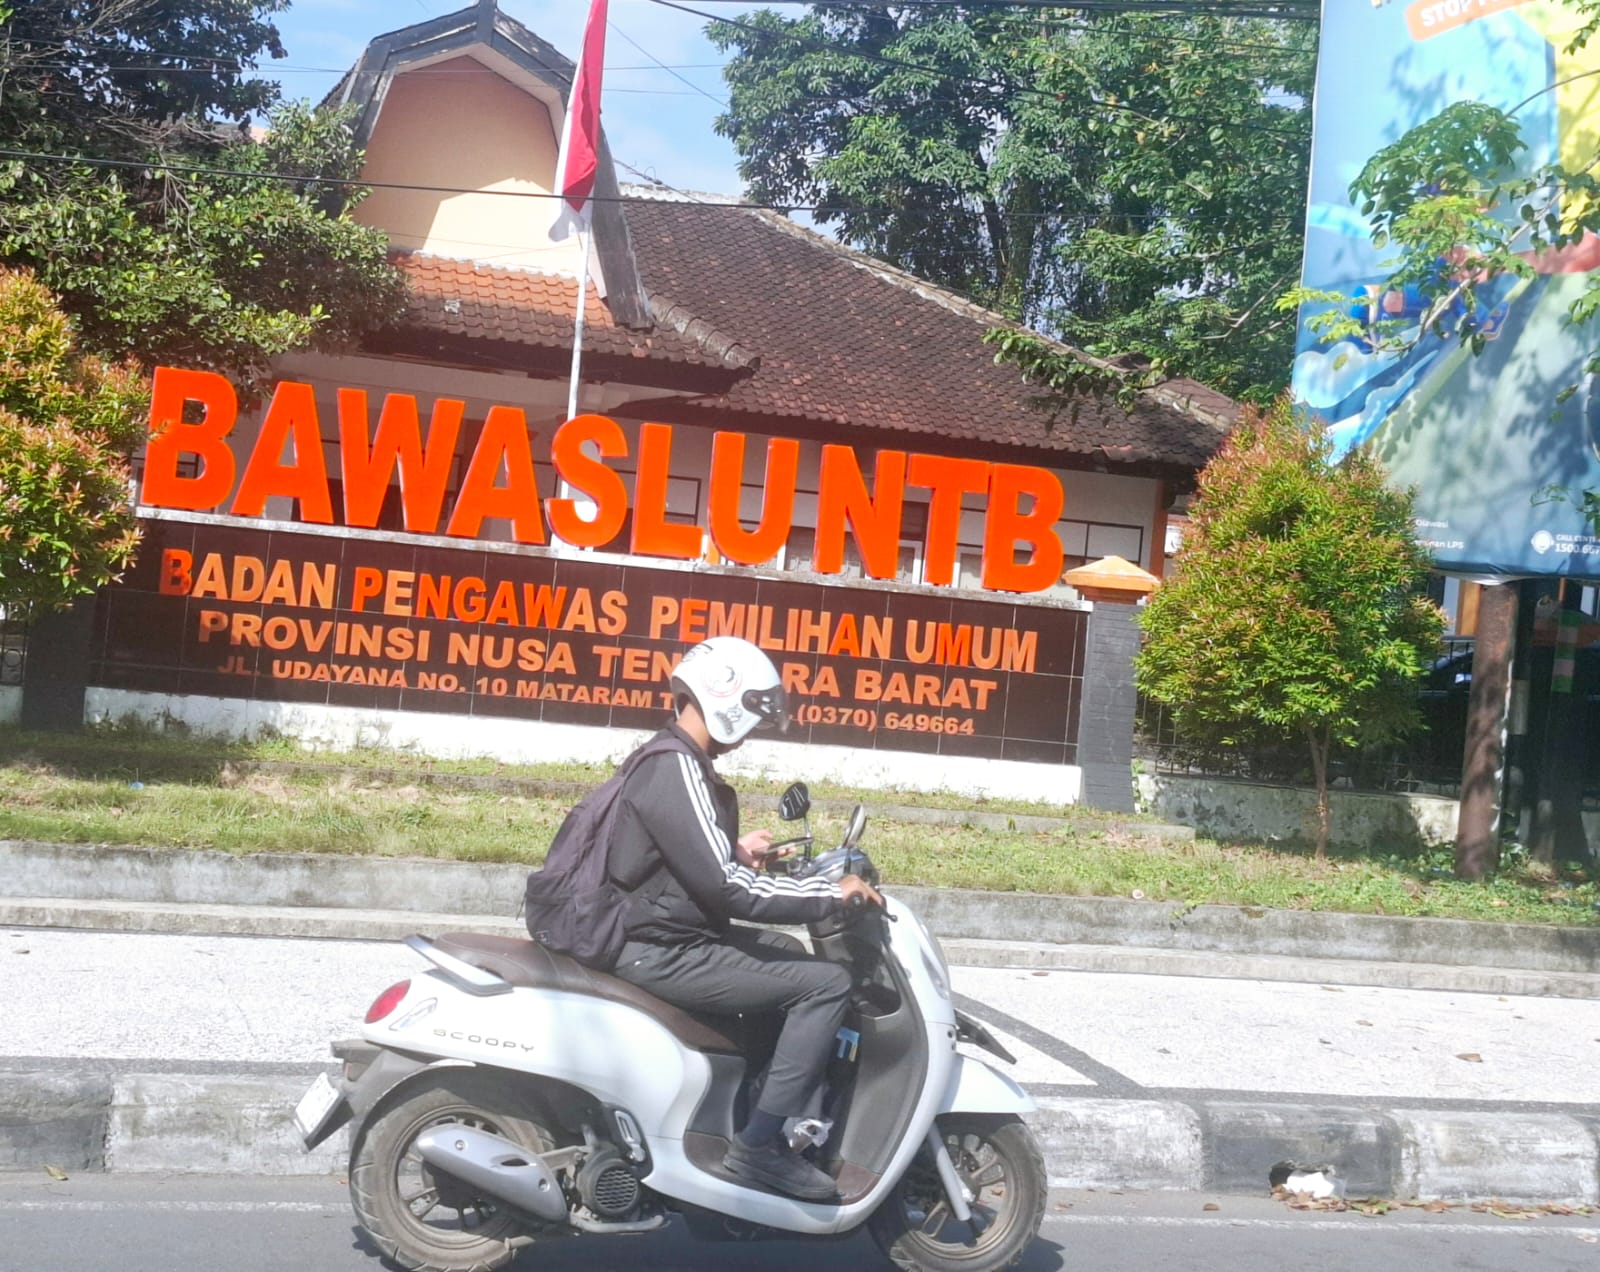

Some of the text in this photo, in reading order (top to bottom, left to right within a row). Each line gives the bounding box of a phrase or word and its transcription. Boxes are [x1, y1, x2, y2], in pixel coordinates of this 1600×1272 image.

[158, 548, 1038, 673] BADAN PENGAWAS PEMILIHAN UMUM
[200, 610, 430, 661] PROVINSI
[447, 632, 576, 675] NUSA
[592, 645, 840, 698] TENRA
[854, 669, 997, 711] BARAT
[217, 656, 260, 677] JL.
[272, 659, 408, 689] UDAYANA
[418, 671, 466, 693] NO.
[476, 677, 508, 697] 10
[516, 680, 652, 709] MATARAM
[798, 704, 877, 732] (0370)
[884, 712, 974, 735] 649664
[433, 1028, 534, 1052] SCOOPY
